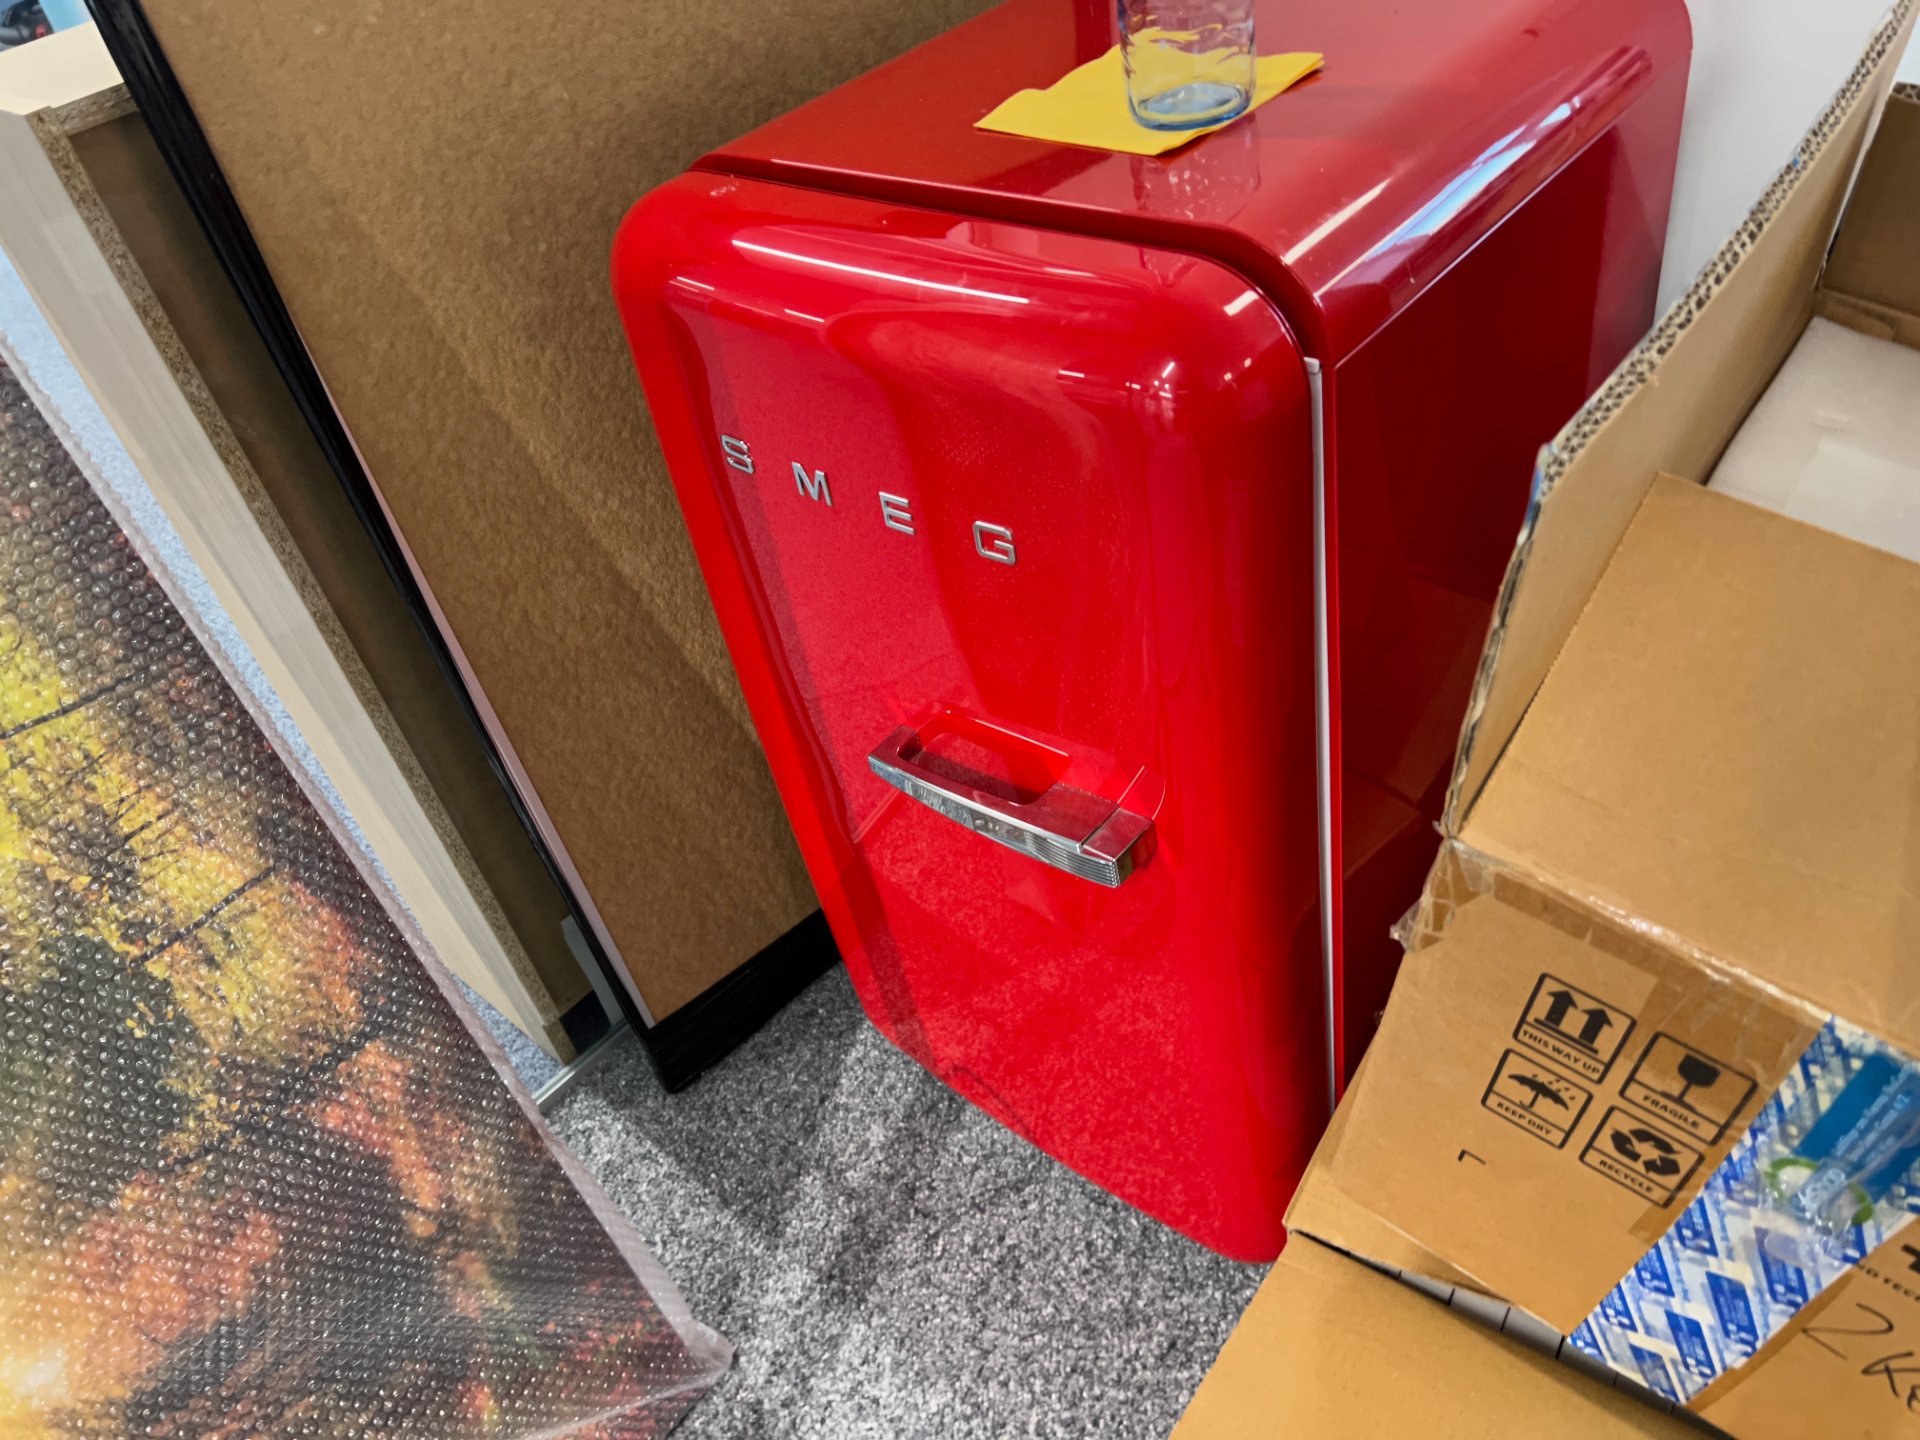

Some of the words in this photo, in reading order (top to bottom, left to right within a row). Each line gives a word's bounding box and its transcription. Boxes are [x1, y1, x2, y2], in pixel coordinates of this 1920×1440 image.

[721, 434, 1017, 566] SMEG
[1522, 1029, 1550, 1049] THIS
[1552, 1044, 1581, 1063] WAY
[1582, 1061, 1600, 1075] UP
[1497, 1101, 1526, 1119] KEEP
[1527, 1118, 1551, 1135] DRY
[1643, 1095, 1699, 1129] FRAGILE
[1599, 1159, 1653, 1193] RECYCLE
